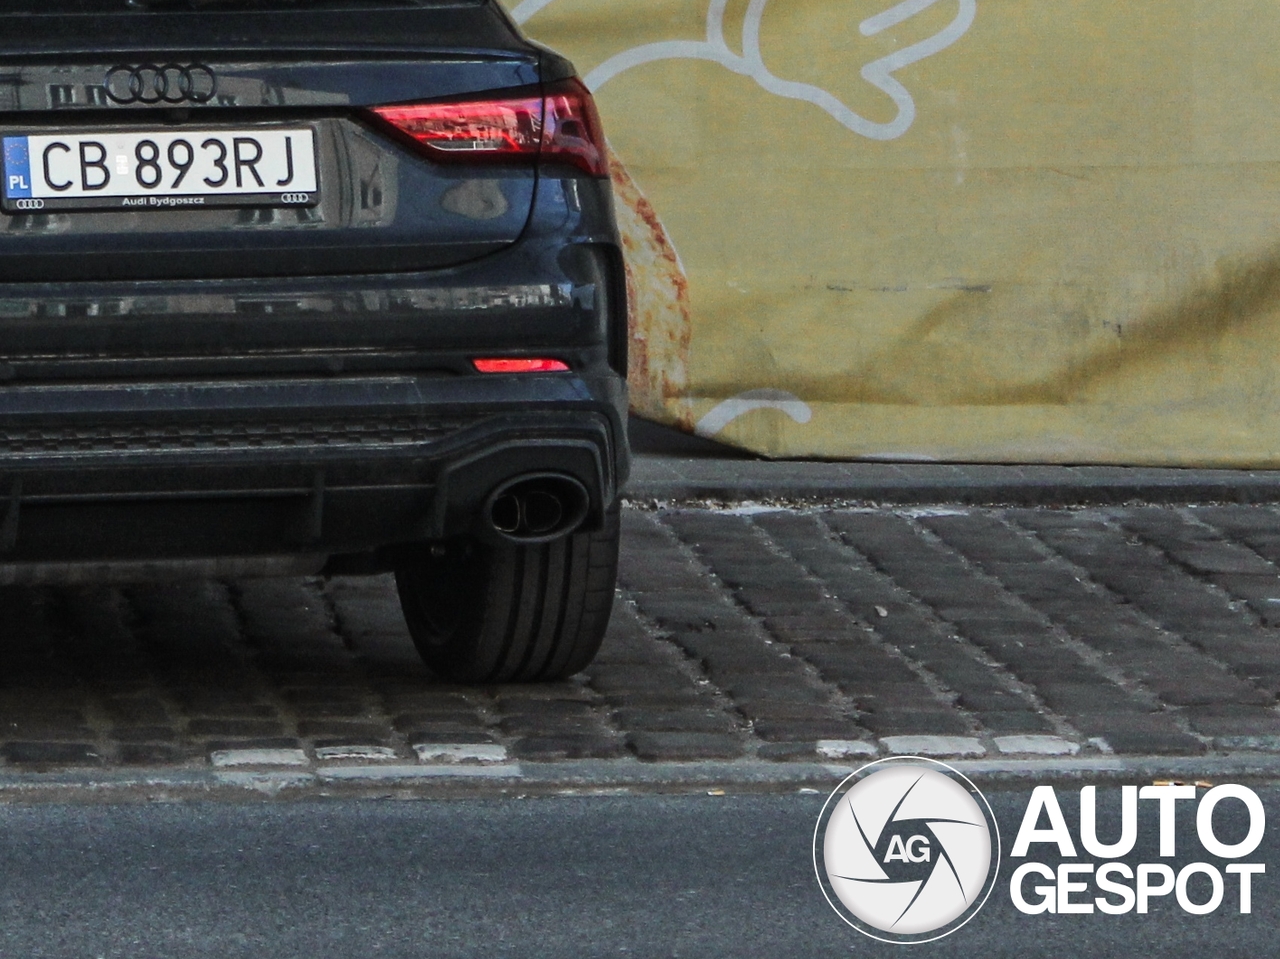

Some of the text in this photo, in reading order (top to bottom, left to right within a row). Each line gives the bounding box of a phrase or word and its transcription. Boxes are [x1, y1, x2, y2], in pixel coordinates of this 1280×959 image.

[42, 136, 295, 191] CB 893RJ
[9, 176, 28, 190] PL
[122, 196, 205, 207] Audi Bydgoszcz
